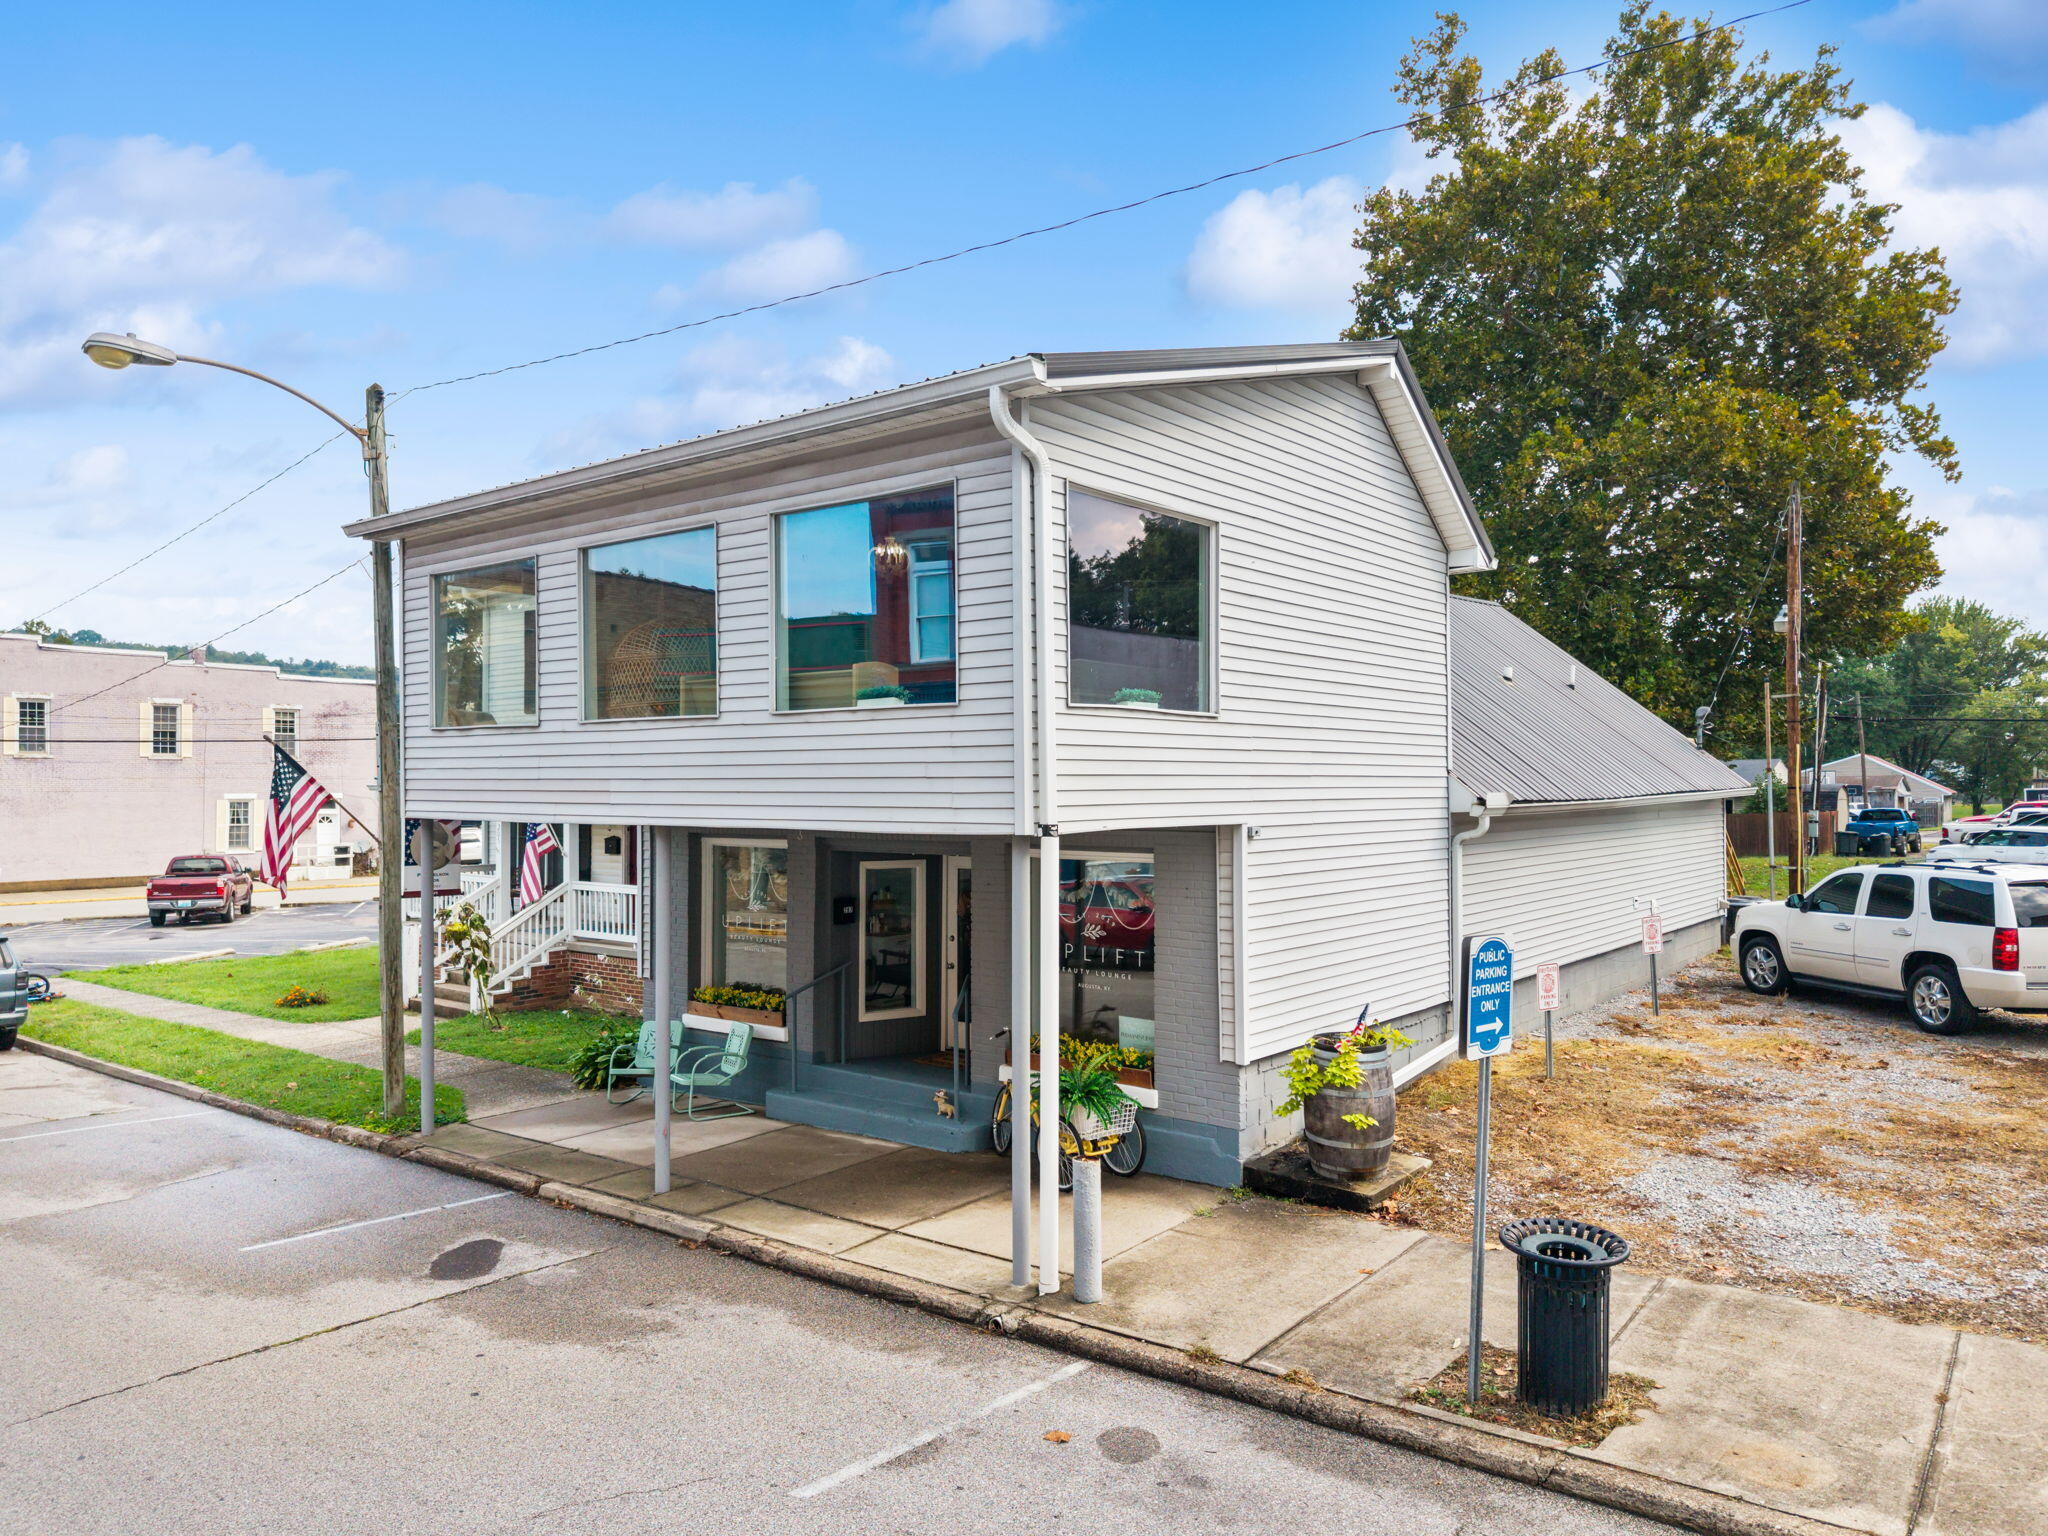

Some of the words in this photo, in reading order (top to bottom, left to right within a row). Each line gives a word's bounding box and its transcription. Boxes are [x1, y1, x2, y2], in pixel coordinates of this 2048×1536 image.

[722, 914, 787, 933] UPLIFT
[1065, 943, 1145, 968] PLIFT
[1479, 949, 1505, 964] PUBLIC
[1062, 966, 1090, 976] EAUTY
[1096, 970, 1132, 981] LOUNGE
[1475, 965, 1507, 981] PARKING
[1471, 981, 1511, 998] ENTRANCE
[1480, 999, 1500, 1012] ONLY
